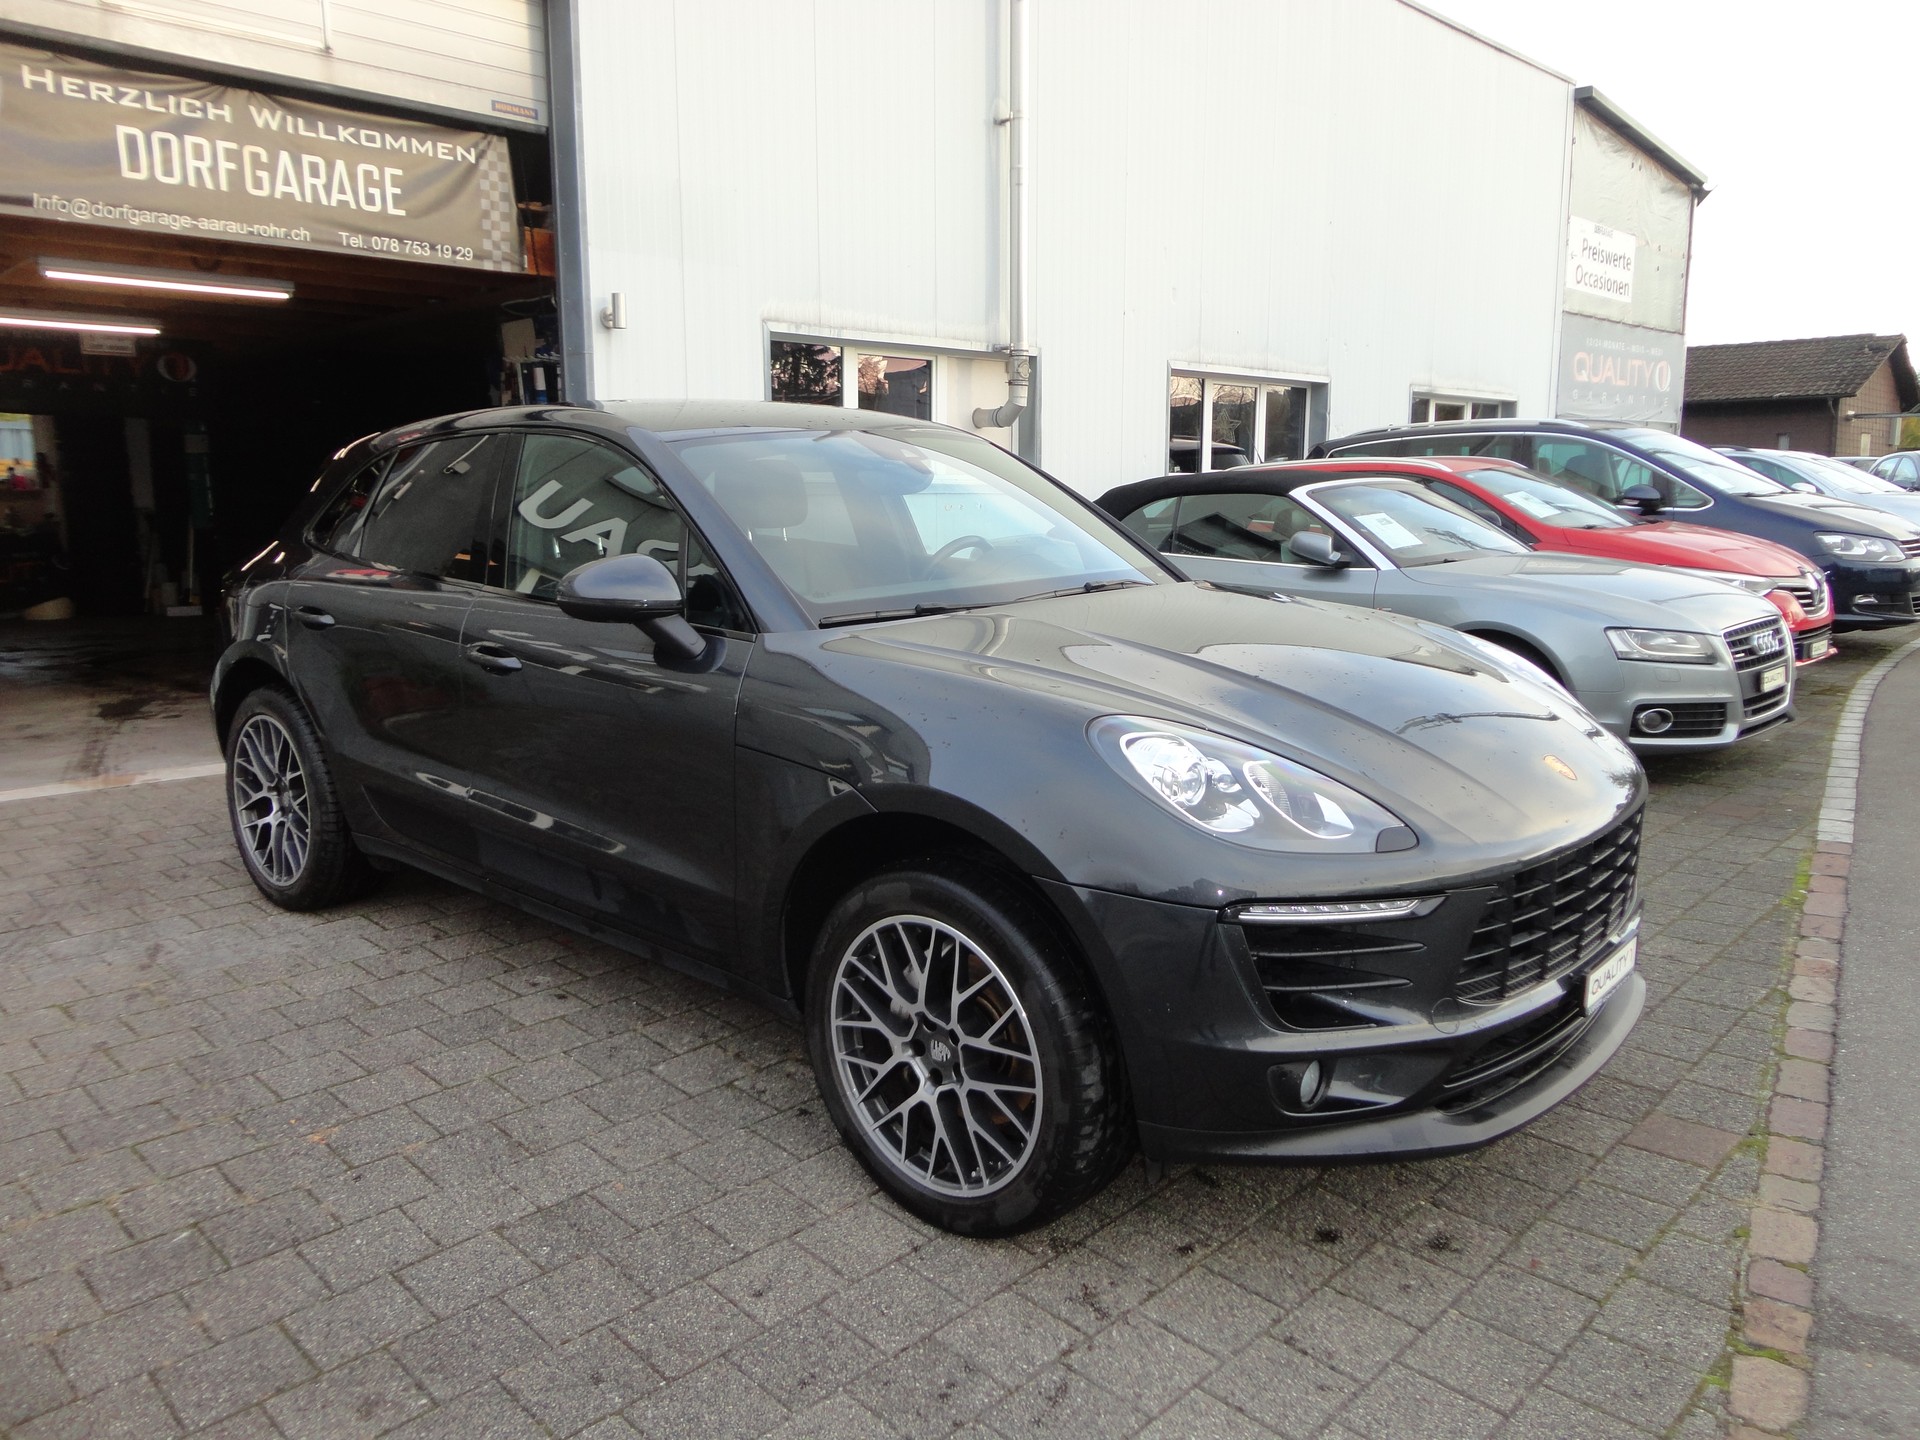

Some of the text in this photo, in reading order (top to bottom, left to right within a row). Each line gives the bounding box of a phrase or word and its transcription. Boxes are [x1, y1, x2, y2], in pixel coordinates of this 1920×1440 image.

[21, 64, 477, 164] HERZLICH WILLKOMMEN
[116, 124, 406, 217] DORFGARAGE
[32, 192, 311, 242] Info@dorfgarage-aarau-rohr.ch
[338, 232, 473, 261] Tel. 078 753 19 29
[1582, 238, 1632, 272] Preiswerte
[1575, 264, 1630, 297] Occasionen
